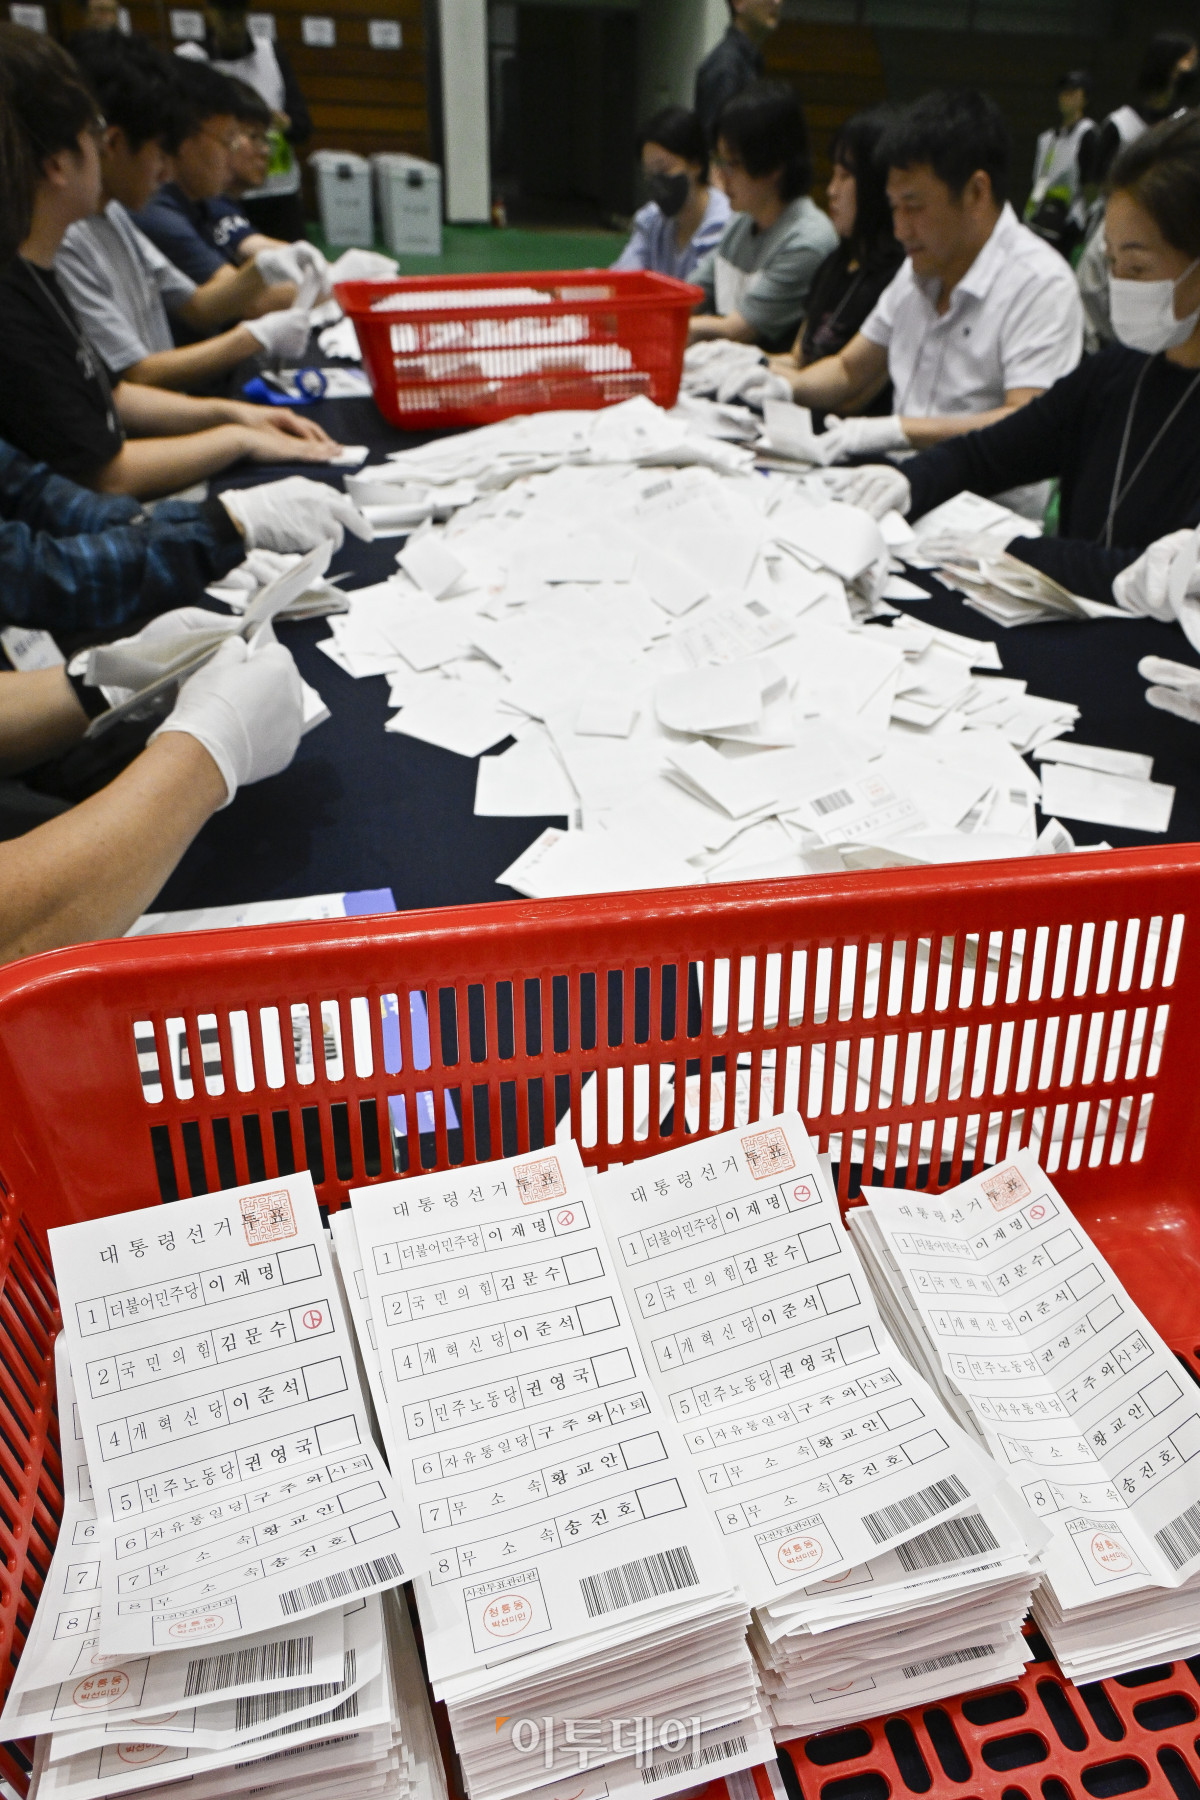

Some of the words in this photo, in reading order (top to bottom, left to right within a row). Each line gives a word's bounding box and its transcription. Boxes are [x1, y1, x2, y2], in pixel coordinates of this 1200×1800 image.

[629, 1243, 638, 1256] 1
[645, 1213, 718, 1249] 더불어민주당
[383, 1251, 391, 1265] 1
[401, 1232, 480, 1261] 더불어민주당
[901, 1238, 910, 1248] 1
[915, 1239, 971, 1256] 더불어민주당
[918, 1275, 929, 1287] 2
[87, 1308, 99, 1325] 1
[109, 1281, 199, 1319] 더불어민주당
[644, 1292, 656, 1308] 2
[391, 1301, 403, 1316] 2
[939, 1317, 947, 1329] 4
[663, 1345, 673, 1360] 4
[402, 1354, 413, 1369] 4
[956, 1361, 966, 1375] 5
[971, 1354, 1036, 1375] 민주노동당
[97, 1368, 110, 1386] 2
[980, 1402, 990, 1413] 6
[995, 1398, 1062, 1416] 자유통일당
[1117, 1337, 1149, 1364] 사퇴
[679, 1399, 691, 1415] 5
[697, 1369, 772, 1408] 민주노동당
[413, 1411, 425, 1428] 5
[434, 1385, 518, 1423] 민주노동당
[694, 1435, 705, 1446] 6
[713, 1410, 791, 1440] 자유통일당
[863, 1372, 896, 1390] 사퇴
[109, 1430, 121, 1448] 4
[422, 1461, 433, 1475] 6
[444, 1433, 529, 1469] 자유통일당
[610, 1397, 646, 1416] 사퇴
[120, 1493, 132, 1511] 5
[143, 1460, 236, 1504] 민주노동당
[709, 1471, 718, 1484] 7
[125, 1537, 137, 1550] 6
[149, 1500, 244, 1541] 자유통일당
[330, 1458, 368, 1476] 사퇴
[1033, 1491, 1047, 1507] 8
[429, 1507, 440, 1522] 7
[726, 1513, 739, 1526] 8
[84, 1526, 95, 1537] 6
[438, 1558, 450, 1574] 8
[77, 1571, 88, 1585] 7
[128, 1574, 140, 1586] 7
[129, 1602, 142, 1610] 8
[66, 1618, 79, 1629] 8
